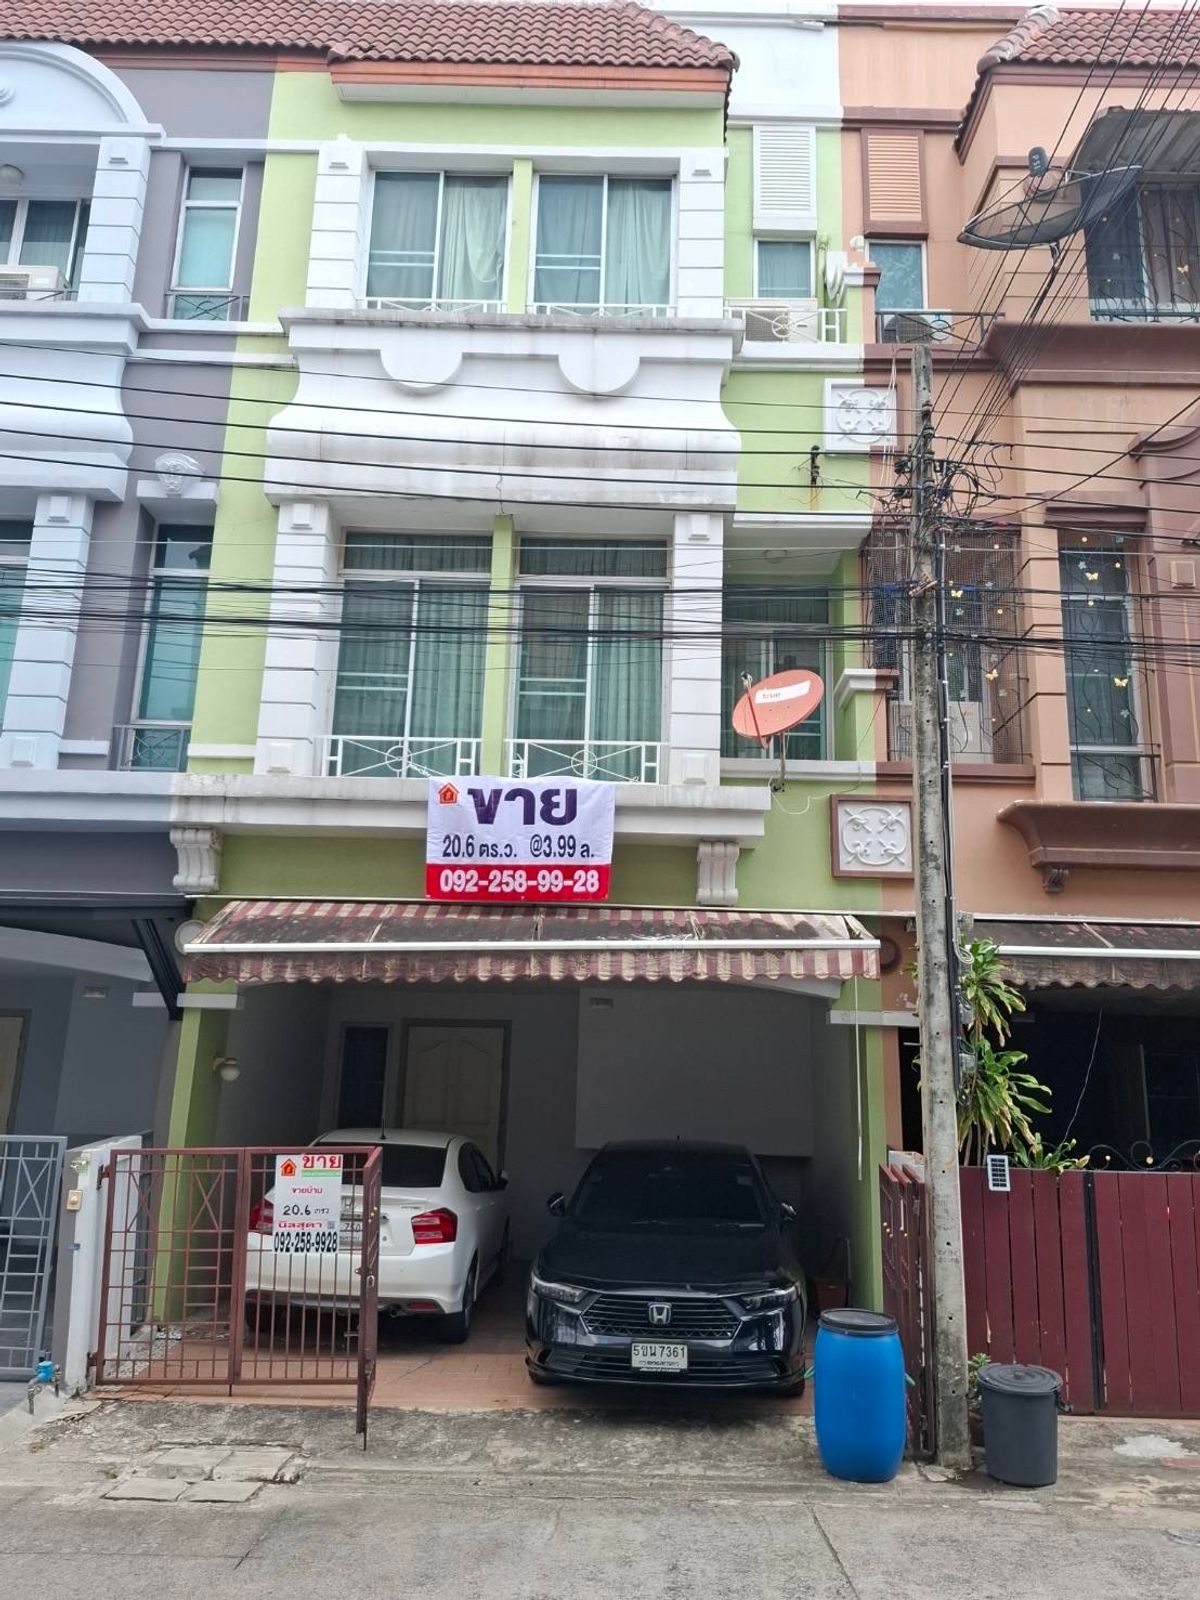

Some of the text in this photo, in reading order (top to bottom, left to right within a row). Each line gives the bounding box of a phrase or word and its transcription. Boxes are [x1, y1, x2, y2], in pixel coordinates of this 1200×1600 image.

[467, 787, 578, 826] ขาย
[442, 834, 595, 858] 20.6 ตร.ว. @3.99 ล.
[439, 869, 600, 893] 092-258-99-28
[302, 1155, 342, 1169] ขาย
[283, 1204, 311, 1216] 20.6
[273, 1231, 338, 1253] 092-258-9928
[659, 1345, 686, 1359] 7361
